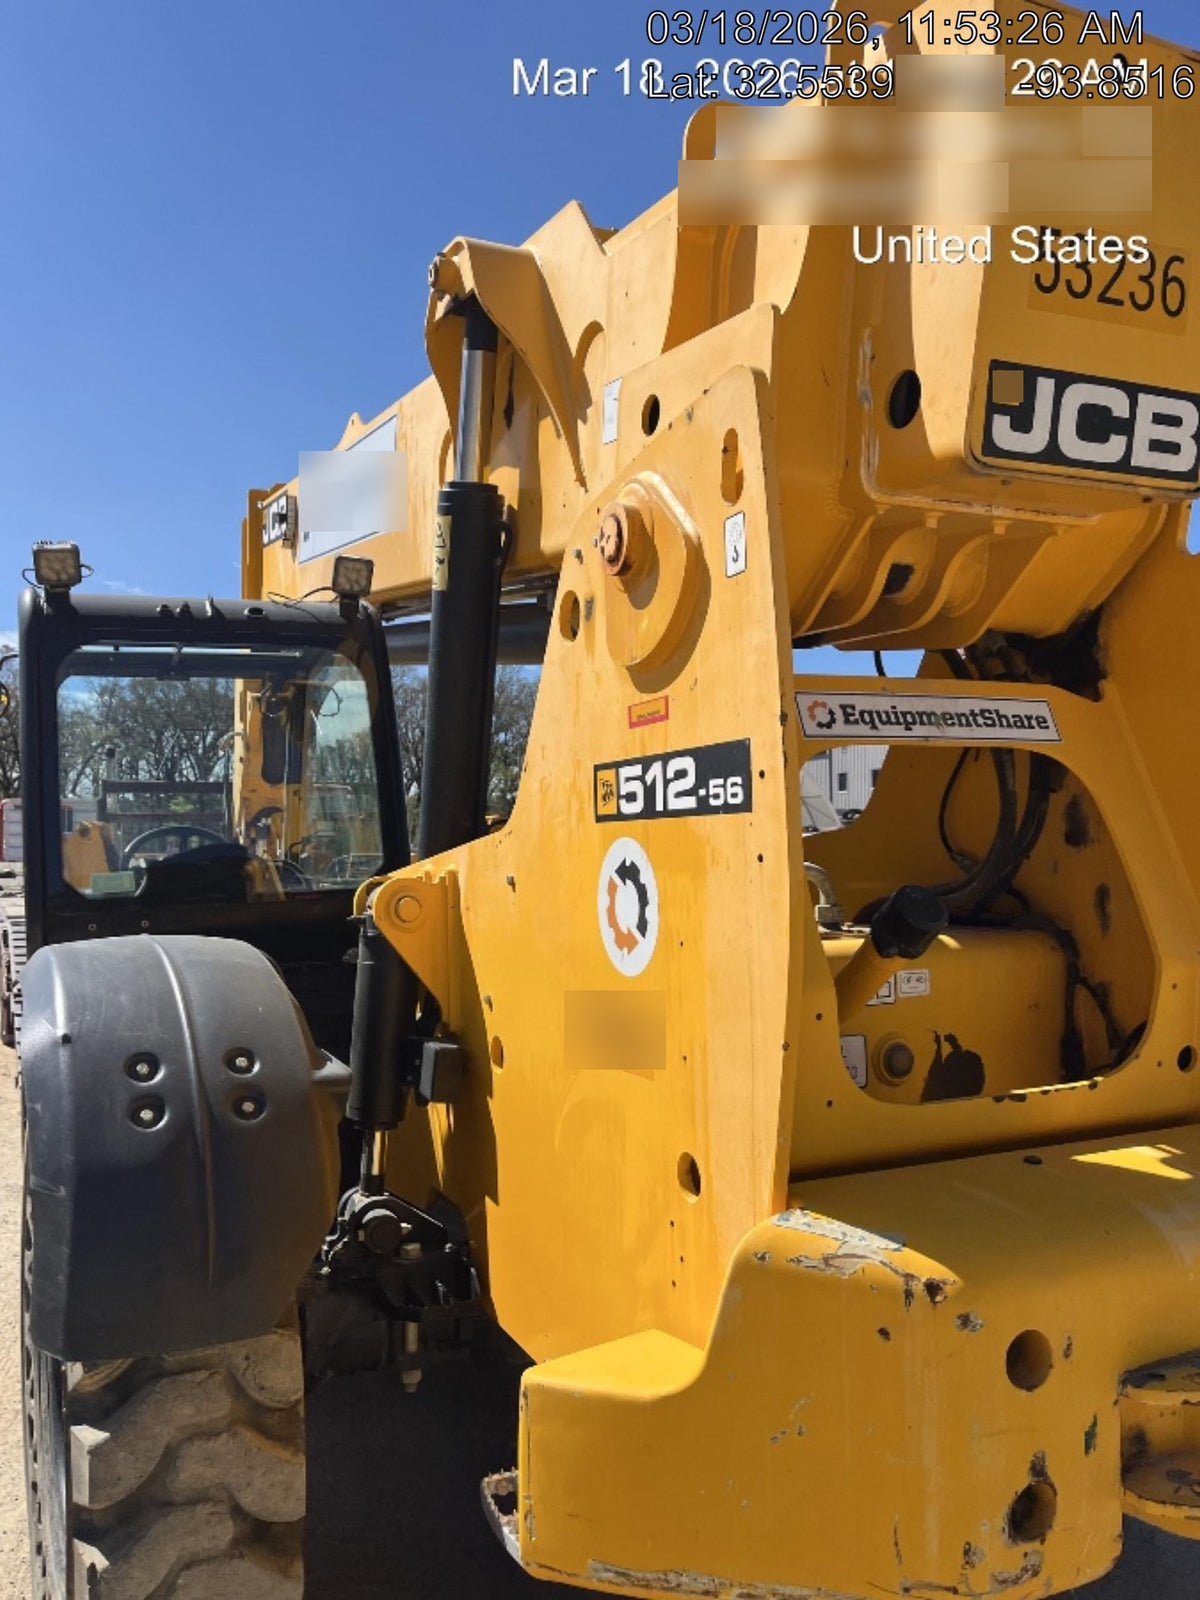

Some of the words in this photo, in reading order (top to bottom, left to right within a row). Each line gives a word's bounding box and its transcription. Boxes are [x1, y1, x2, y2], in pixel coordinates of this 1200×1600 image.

[1034, 226, 1186, 317] 53236
[991, 376, 1200, 472] JCB
[839, 703, 1050, 731] EquipmentShare
[618, 756, 744, 814] 512-56
